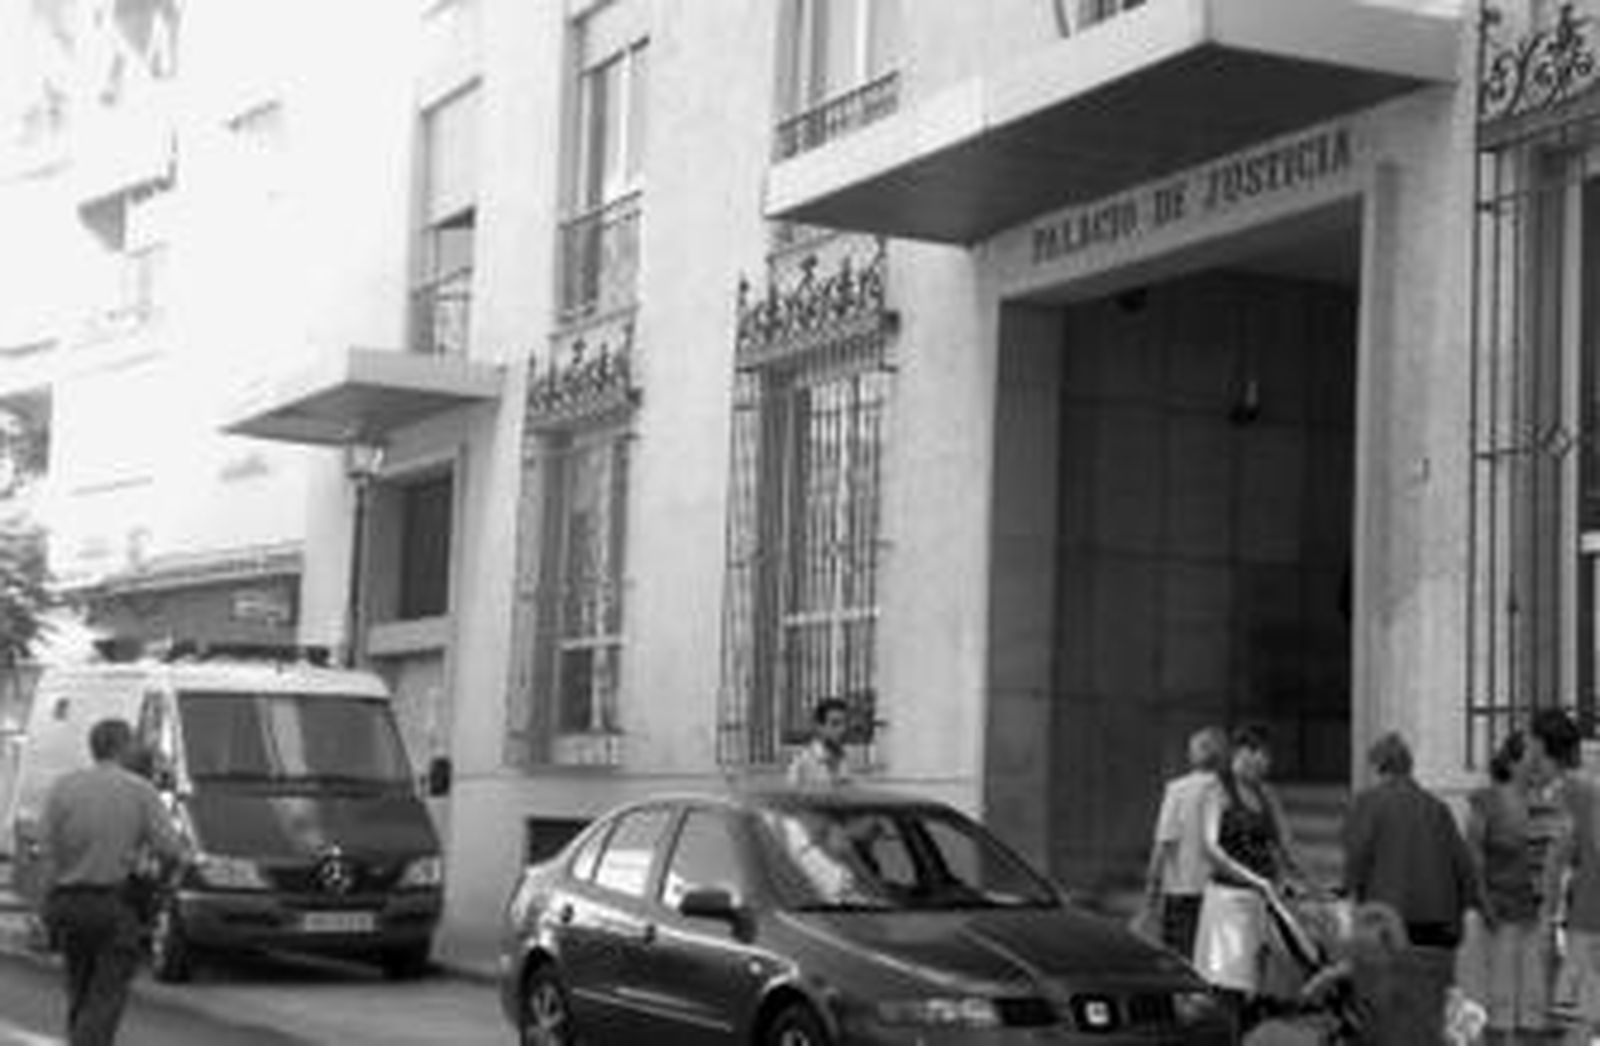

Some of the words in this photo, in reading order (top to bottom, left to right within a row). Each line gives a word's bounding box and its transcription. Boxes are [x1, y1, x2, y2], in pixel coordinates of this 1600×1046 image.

[1033, 201, 1138, 263] PALACIO
[1154, 182, 1187, 227] DE
[1206, 130, 1351, 206] JUSTICIA
